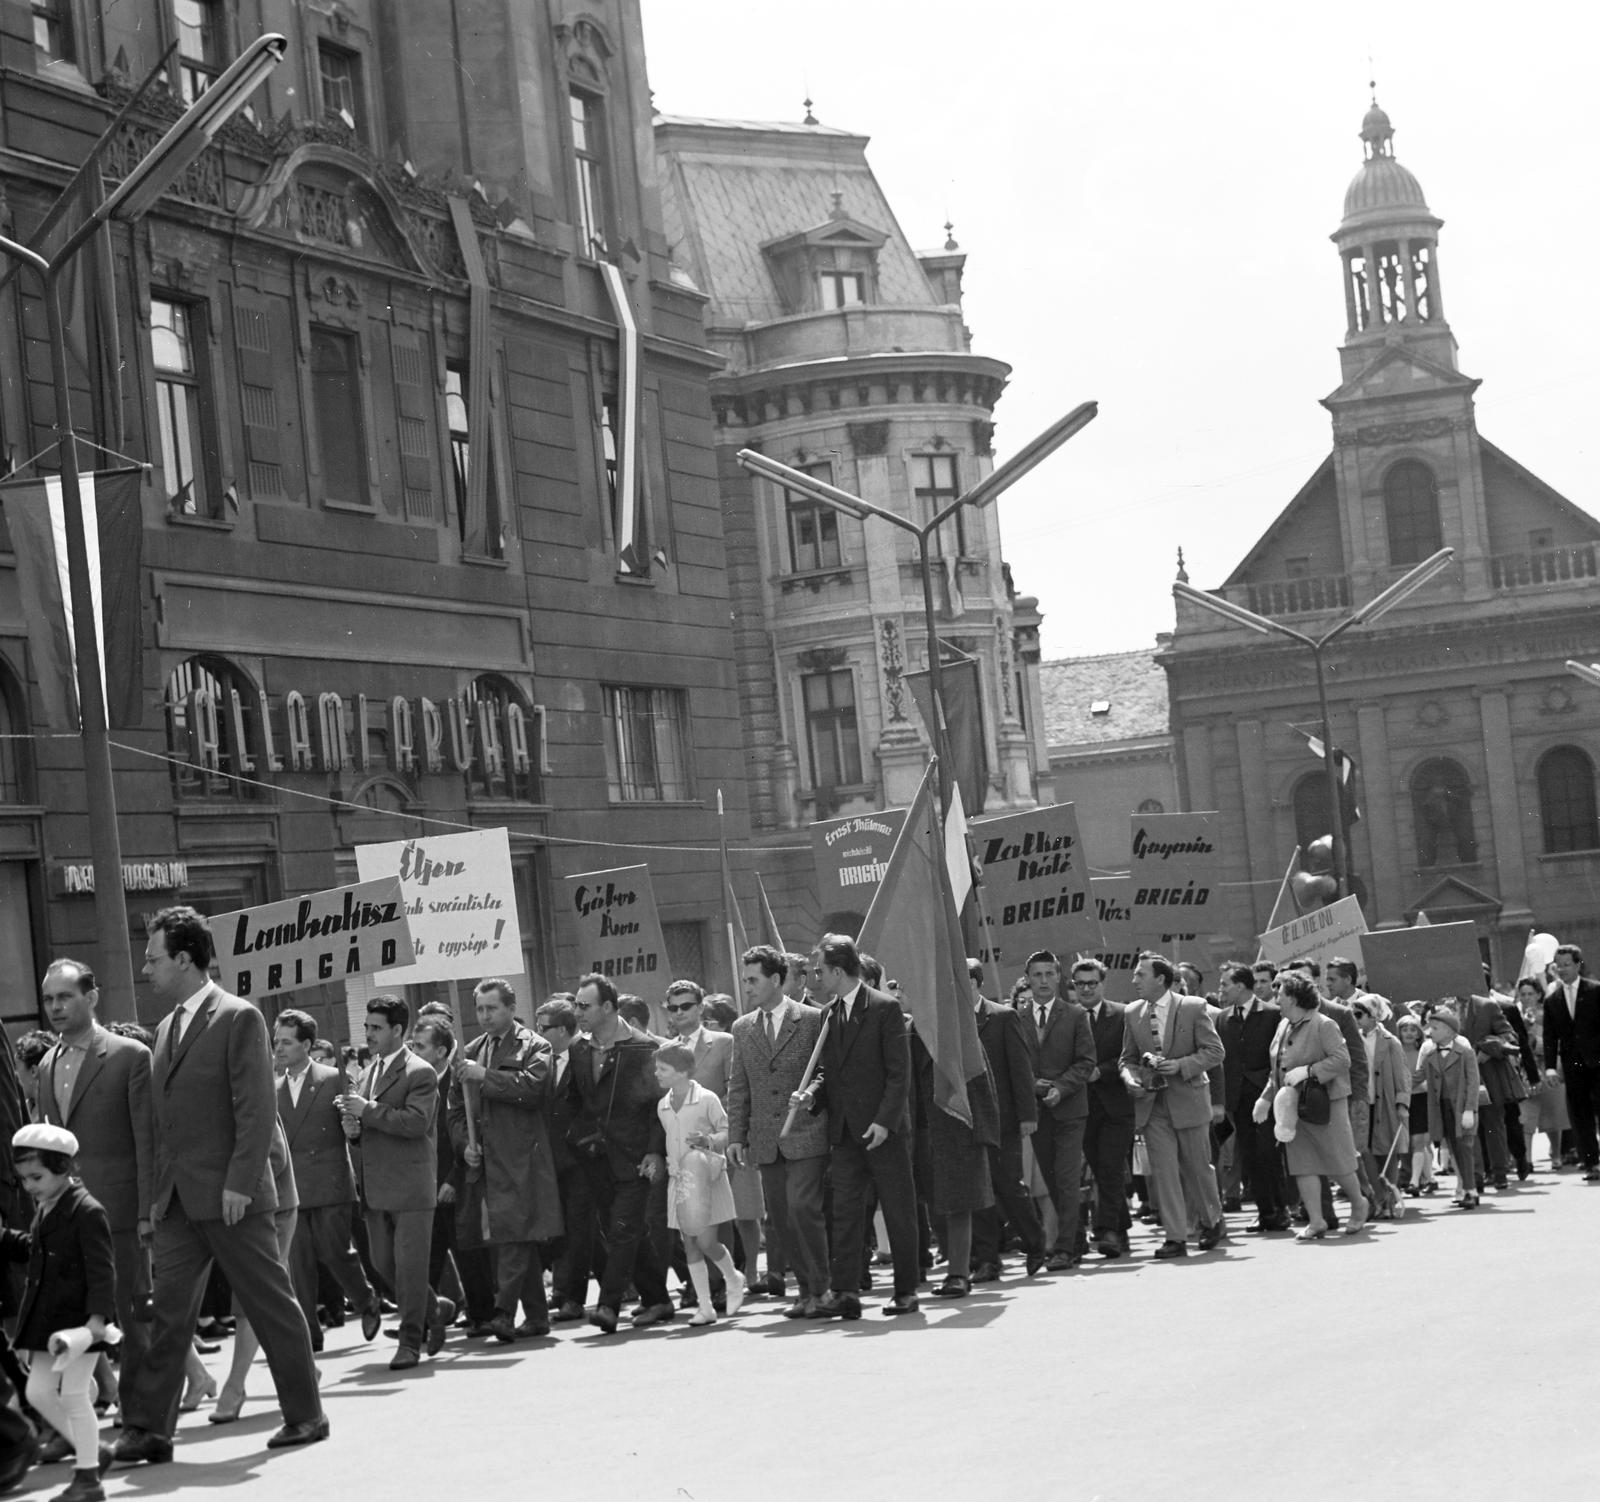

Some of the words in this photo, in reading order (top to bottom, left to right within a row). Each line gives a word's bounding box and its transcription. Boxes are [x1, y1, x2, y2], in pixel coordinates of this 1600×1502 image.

[825, 820, 851, 846] Ernst
[1133, 828, 1214, 860] Gagarin
[399, 840, 466, 886] Éljen
[839, 857, 889, 887] BRIGÁD
[429, 892, 503, 914] szocialista
[575, 883, 637, 918] Gábor
[1002, 887, 1085, 926] BRIGÁD
[1134, 880, 1210, 905] BRIGÁD
[237, 935, 397, 997] BRIGÁD
[592, 947, 657, 977] BRIGÁD
